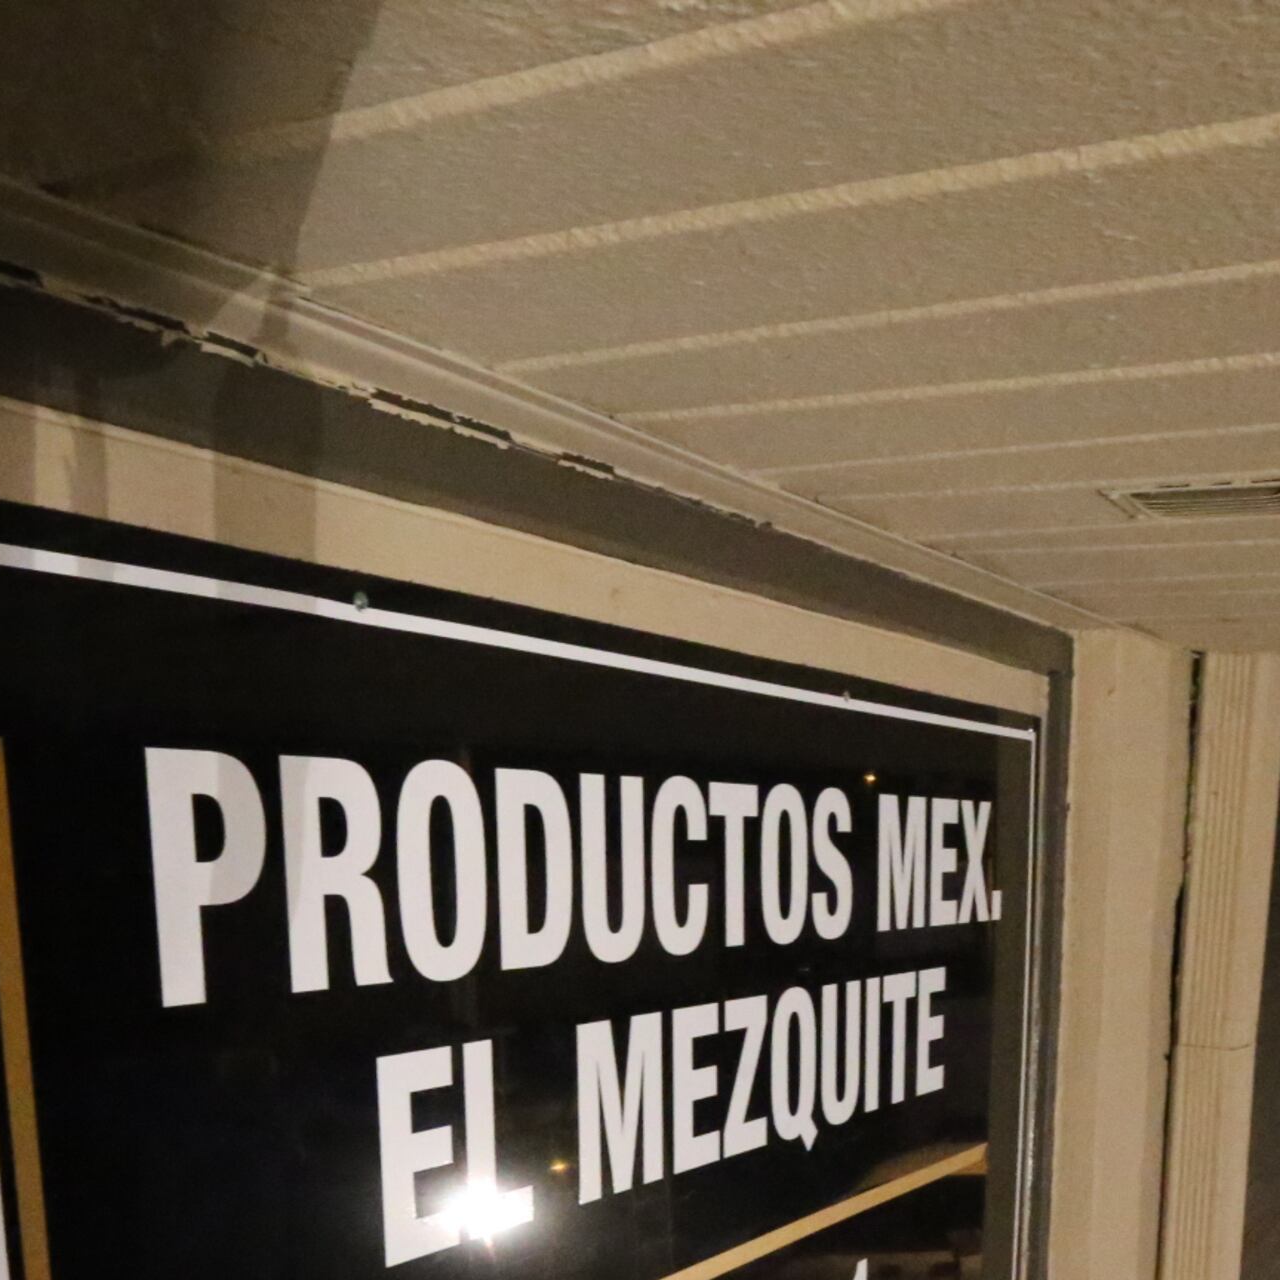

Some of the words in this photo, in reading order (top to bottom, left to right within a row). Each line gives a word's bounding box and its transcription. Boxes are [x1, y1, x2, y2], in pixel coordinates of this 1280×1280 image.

[144, 746, 853, 1008] PRODUCTOS
[877, 793, 1002, 932] MEX.
[375, 1038, 534, 1268] EL
[575, 966, 947, 1206] MEZQUITE
